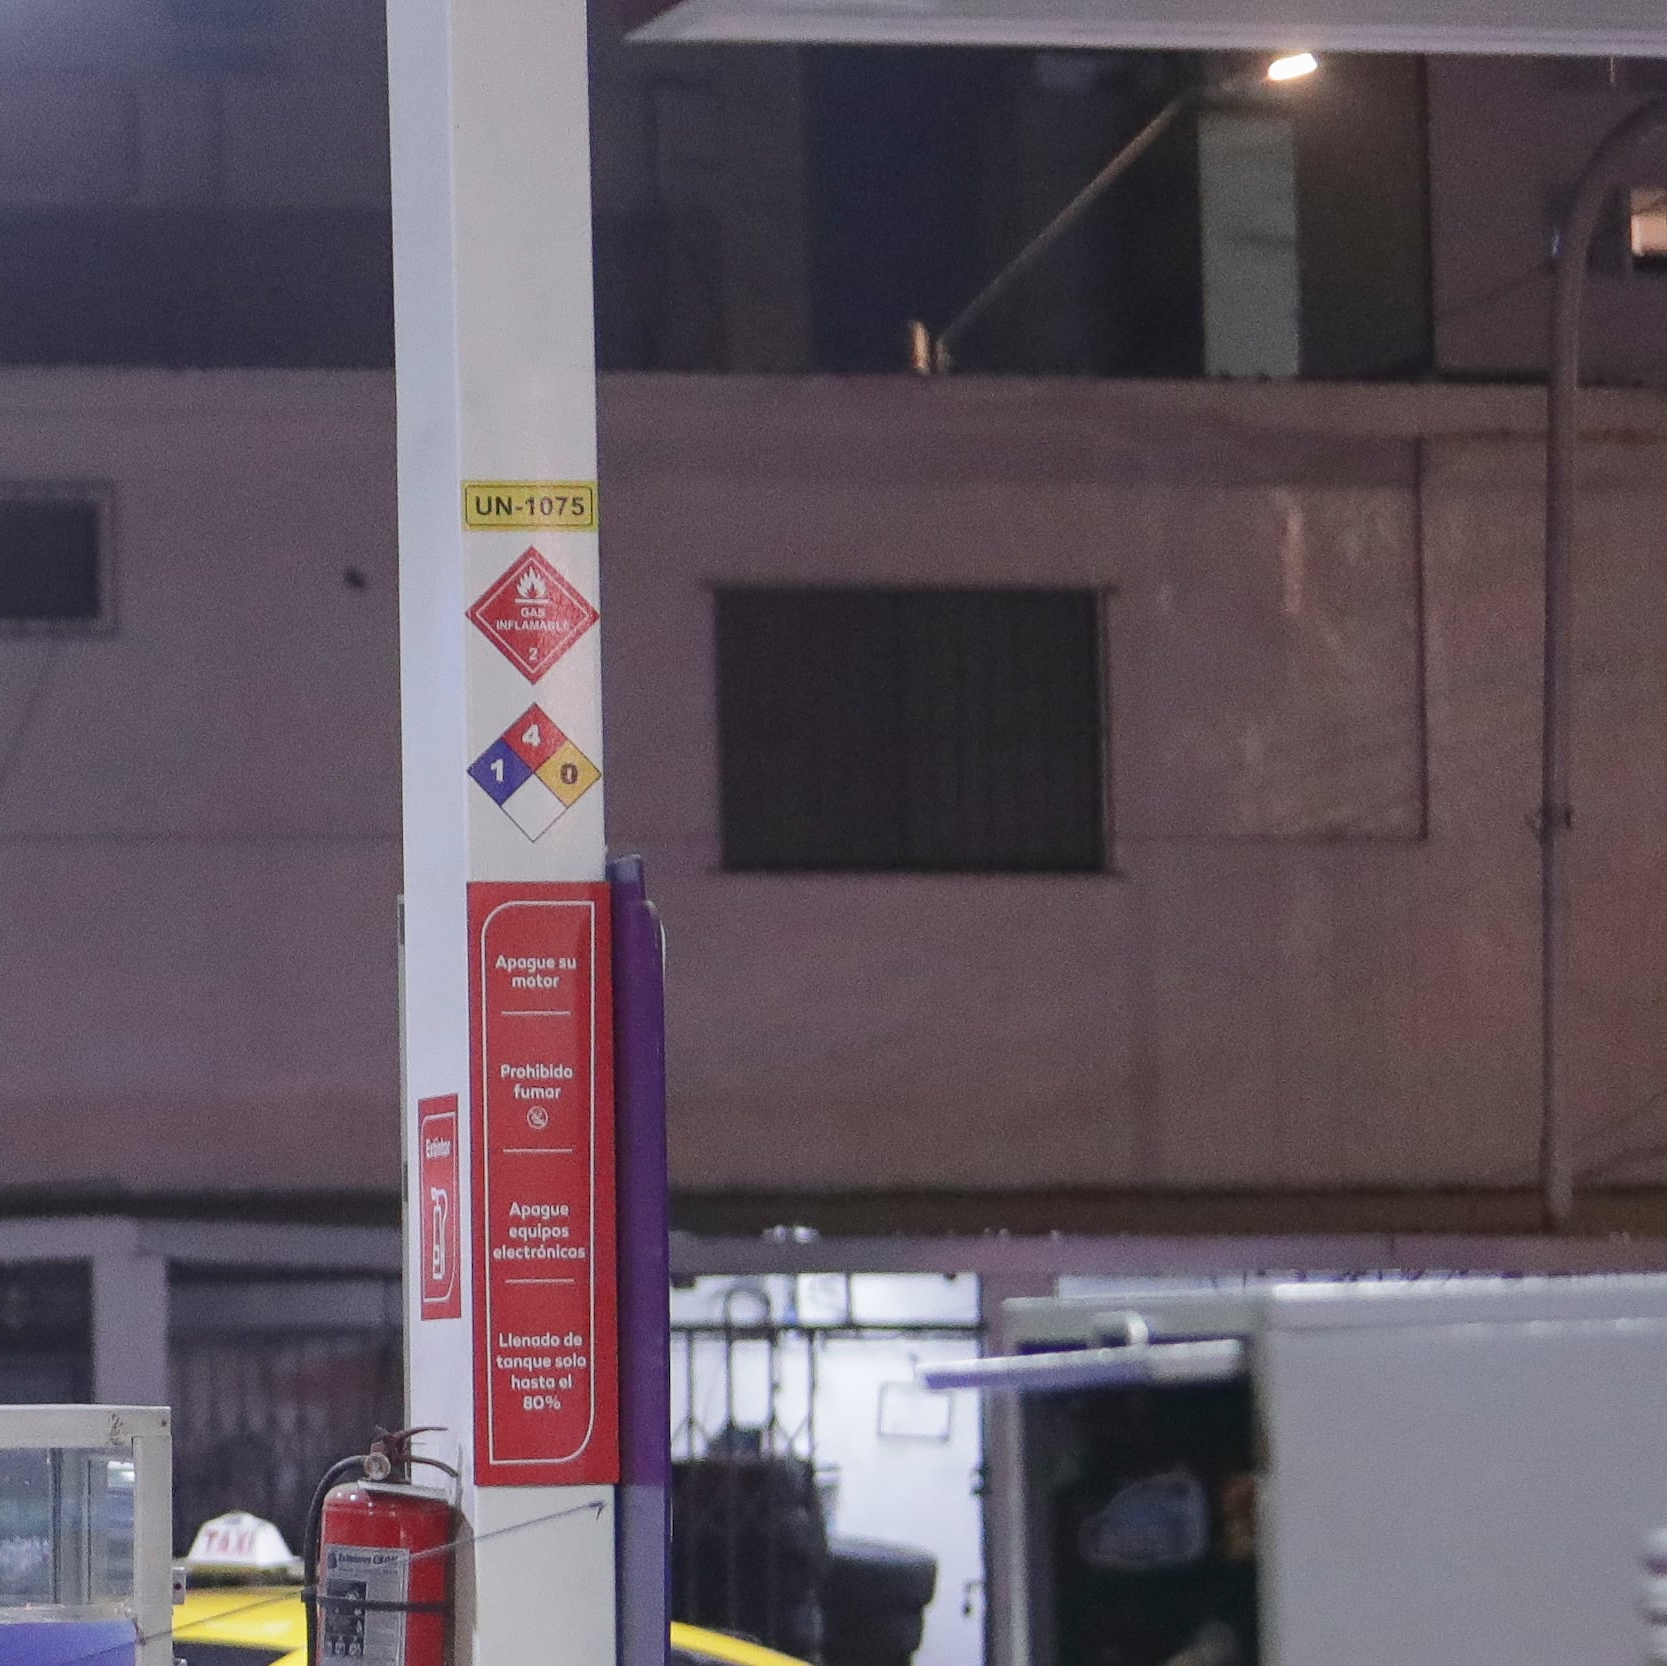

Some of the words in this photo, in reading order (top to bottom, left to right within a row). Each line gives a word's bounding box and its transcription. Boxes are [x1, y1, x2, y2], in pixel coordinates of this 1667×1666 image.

[475, 497, 584, 516] UN-1075
[521, 607, 546, 618] GAS
[529, 647, 539, 661] 2
[522, 724, 541, 747] 4
[491, 759, 504, 782] 1
[560, 763, 578, 785] 0
[496, 954, 555, 972] Apague
[559, 956, 577, 969] su
[512, 972, 559, 988] motor
[500, 1063, 573, 1080] Prohibido
[514, 1083, 561, 1100] fumar
[509, 1202, 569, 1221] Apague
[509, 1223, 569, 1241] equipos
[493, 1243, 586, 1260] electrónicos
[499, 1332, 560, 1348] Llenado
[564, 1333, 582, 1348] de
[496, 1353, 551, 1371] tanque
[555, 1352, 587, 1368] solo
[511, 1374, 555, 1390] hasta
[559, 1374, 572, 1390] el
[523, 1395, 561, 1411] 80%
[204, 1528, 253, 1553] TAXI
